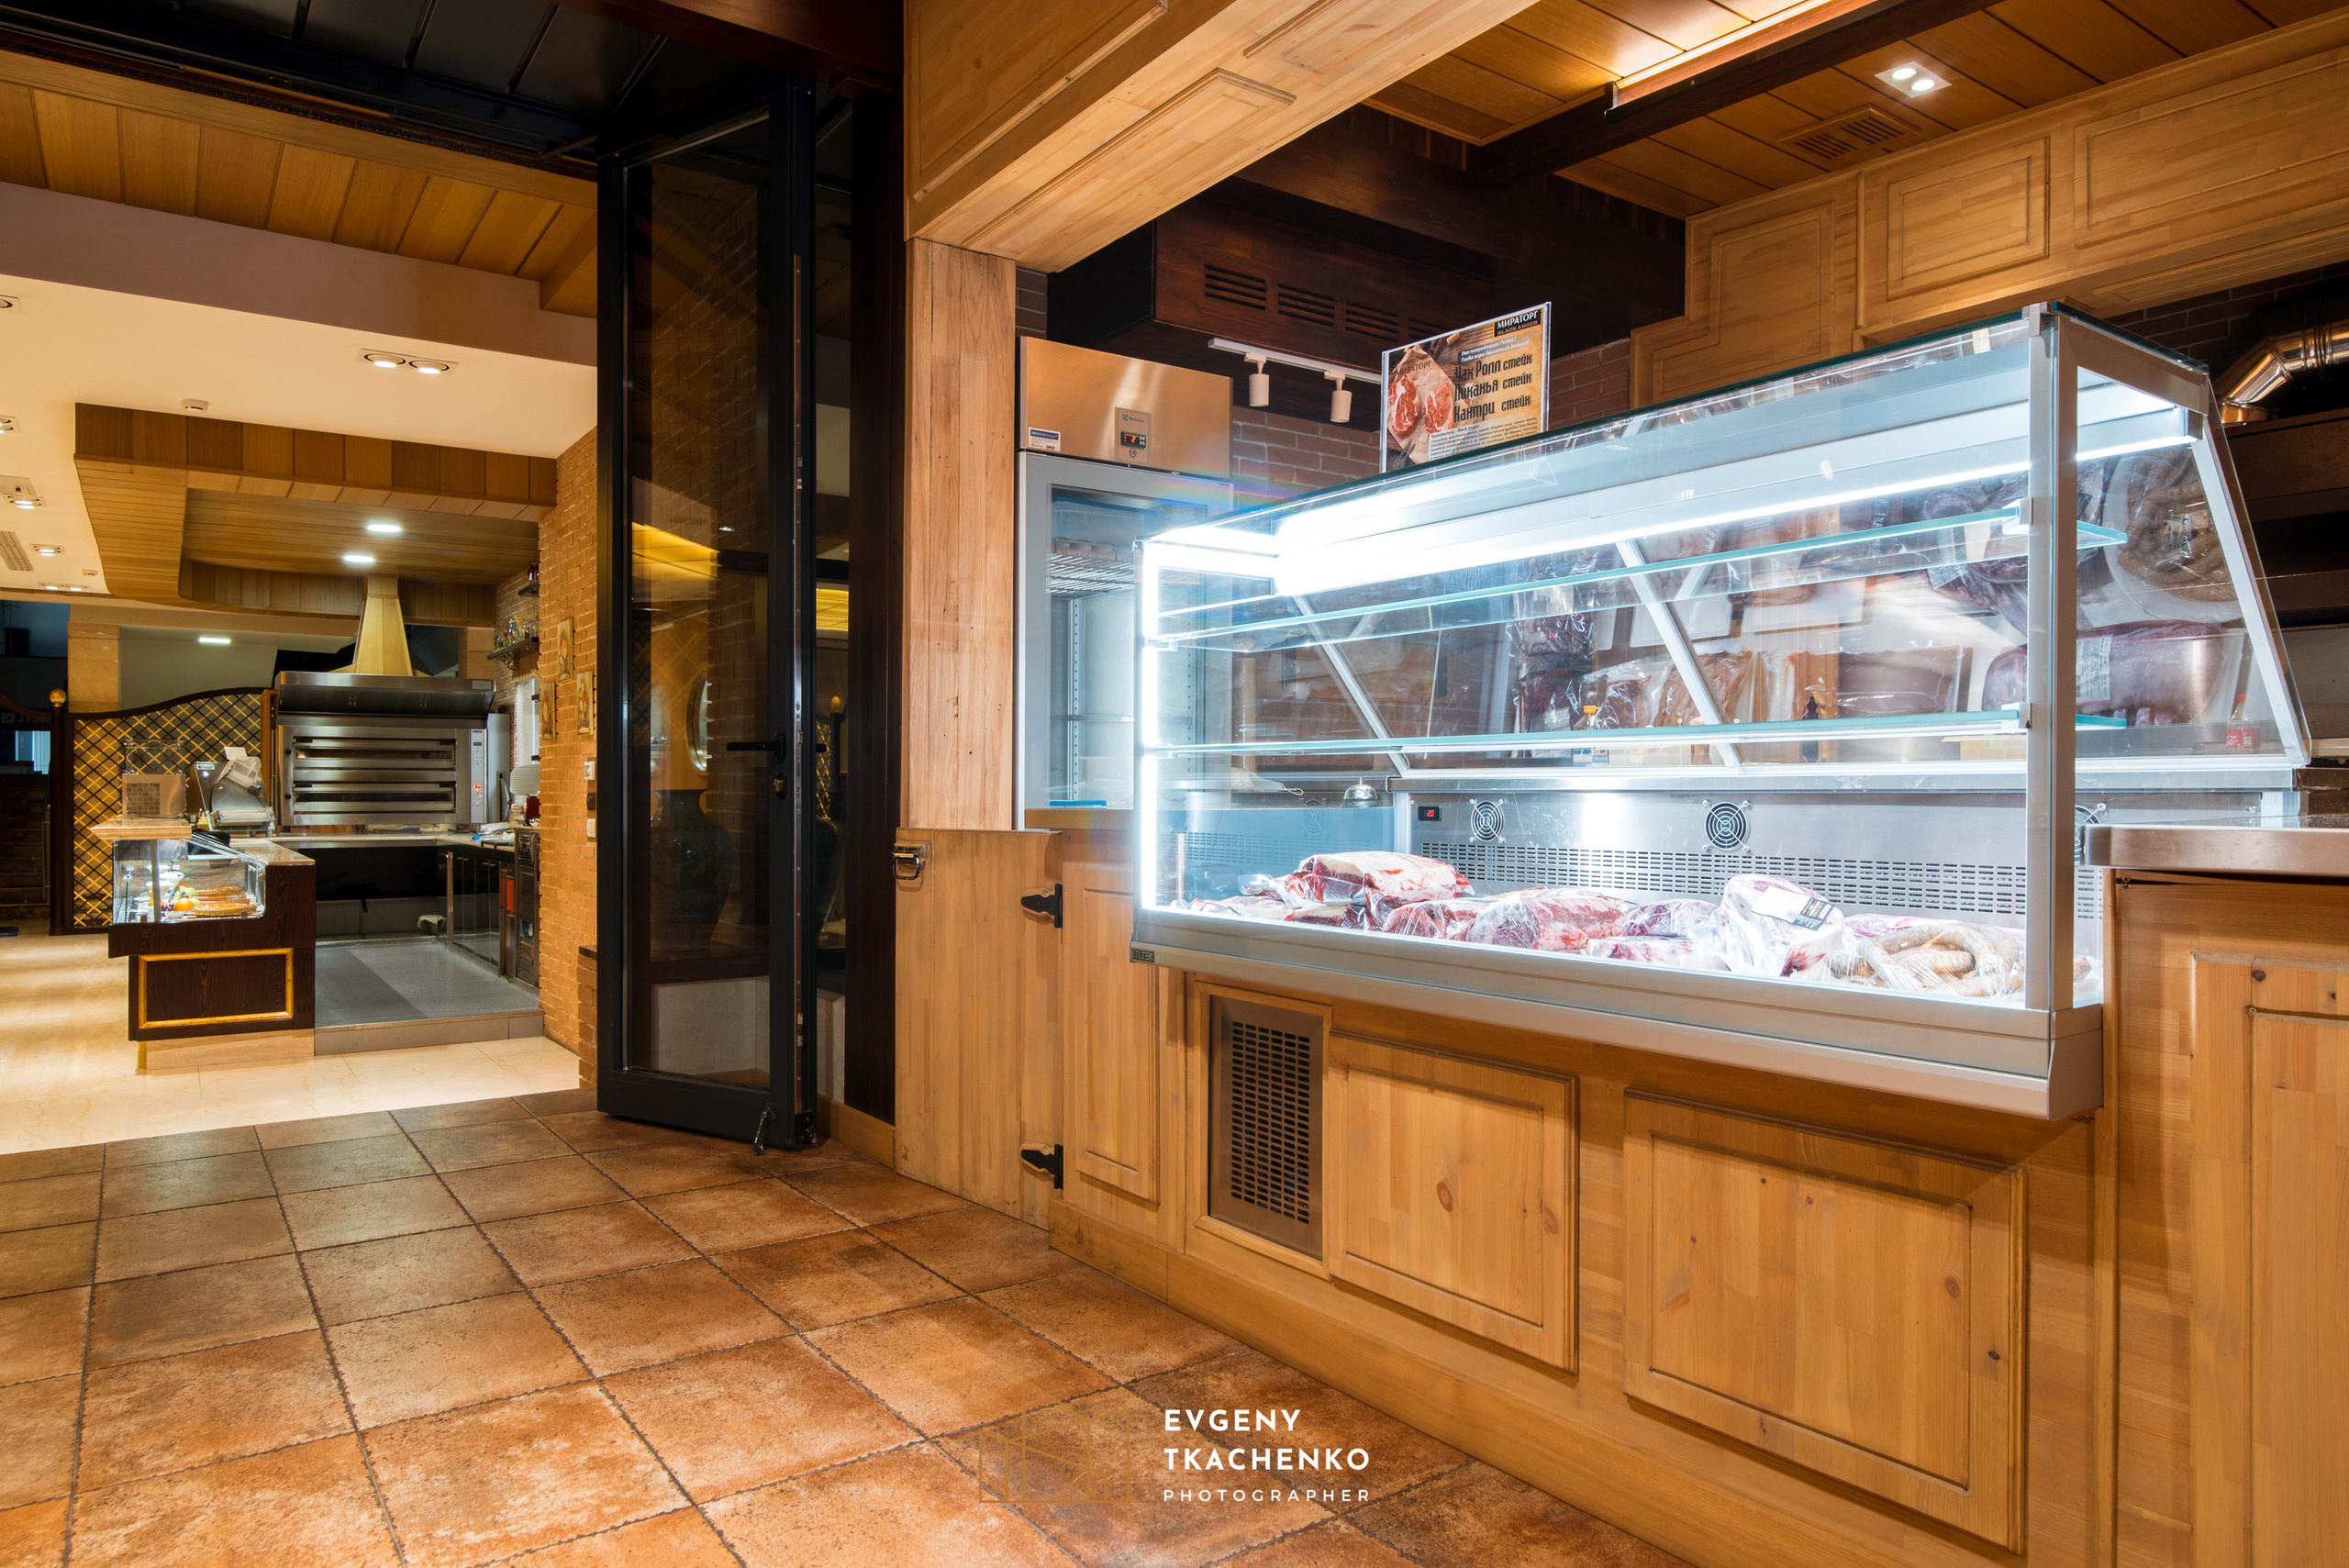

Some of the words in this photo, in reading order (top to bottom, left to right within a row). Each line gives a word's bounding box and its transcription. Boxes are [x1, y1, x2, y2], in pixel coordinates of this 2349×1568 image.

[1497, 310, 1539, 329] МИРАТОРГ
[1497, 326, 1517, 336] BLACK
[1517, 319, 1538, 330] ANGUS
[1455, 365, 1474, 383] Чак
[1475, 360, 1501, 378] Ролл
[1503, 353, 1532, 371] стейк
[1454, 379, 1498, 402] Пиканья
[1502, 373, 1532, 390] стейк
[1453, 401, 1495, 422] Кантри
[1501, 395, 1531, 412] стейк
